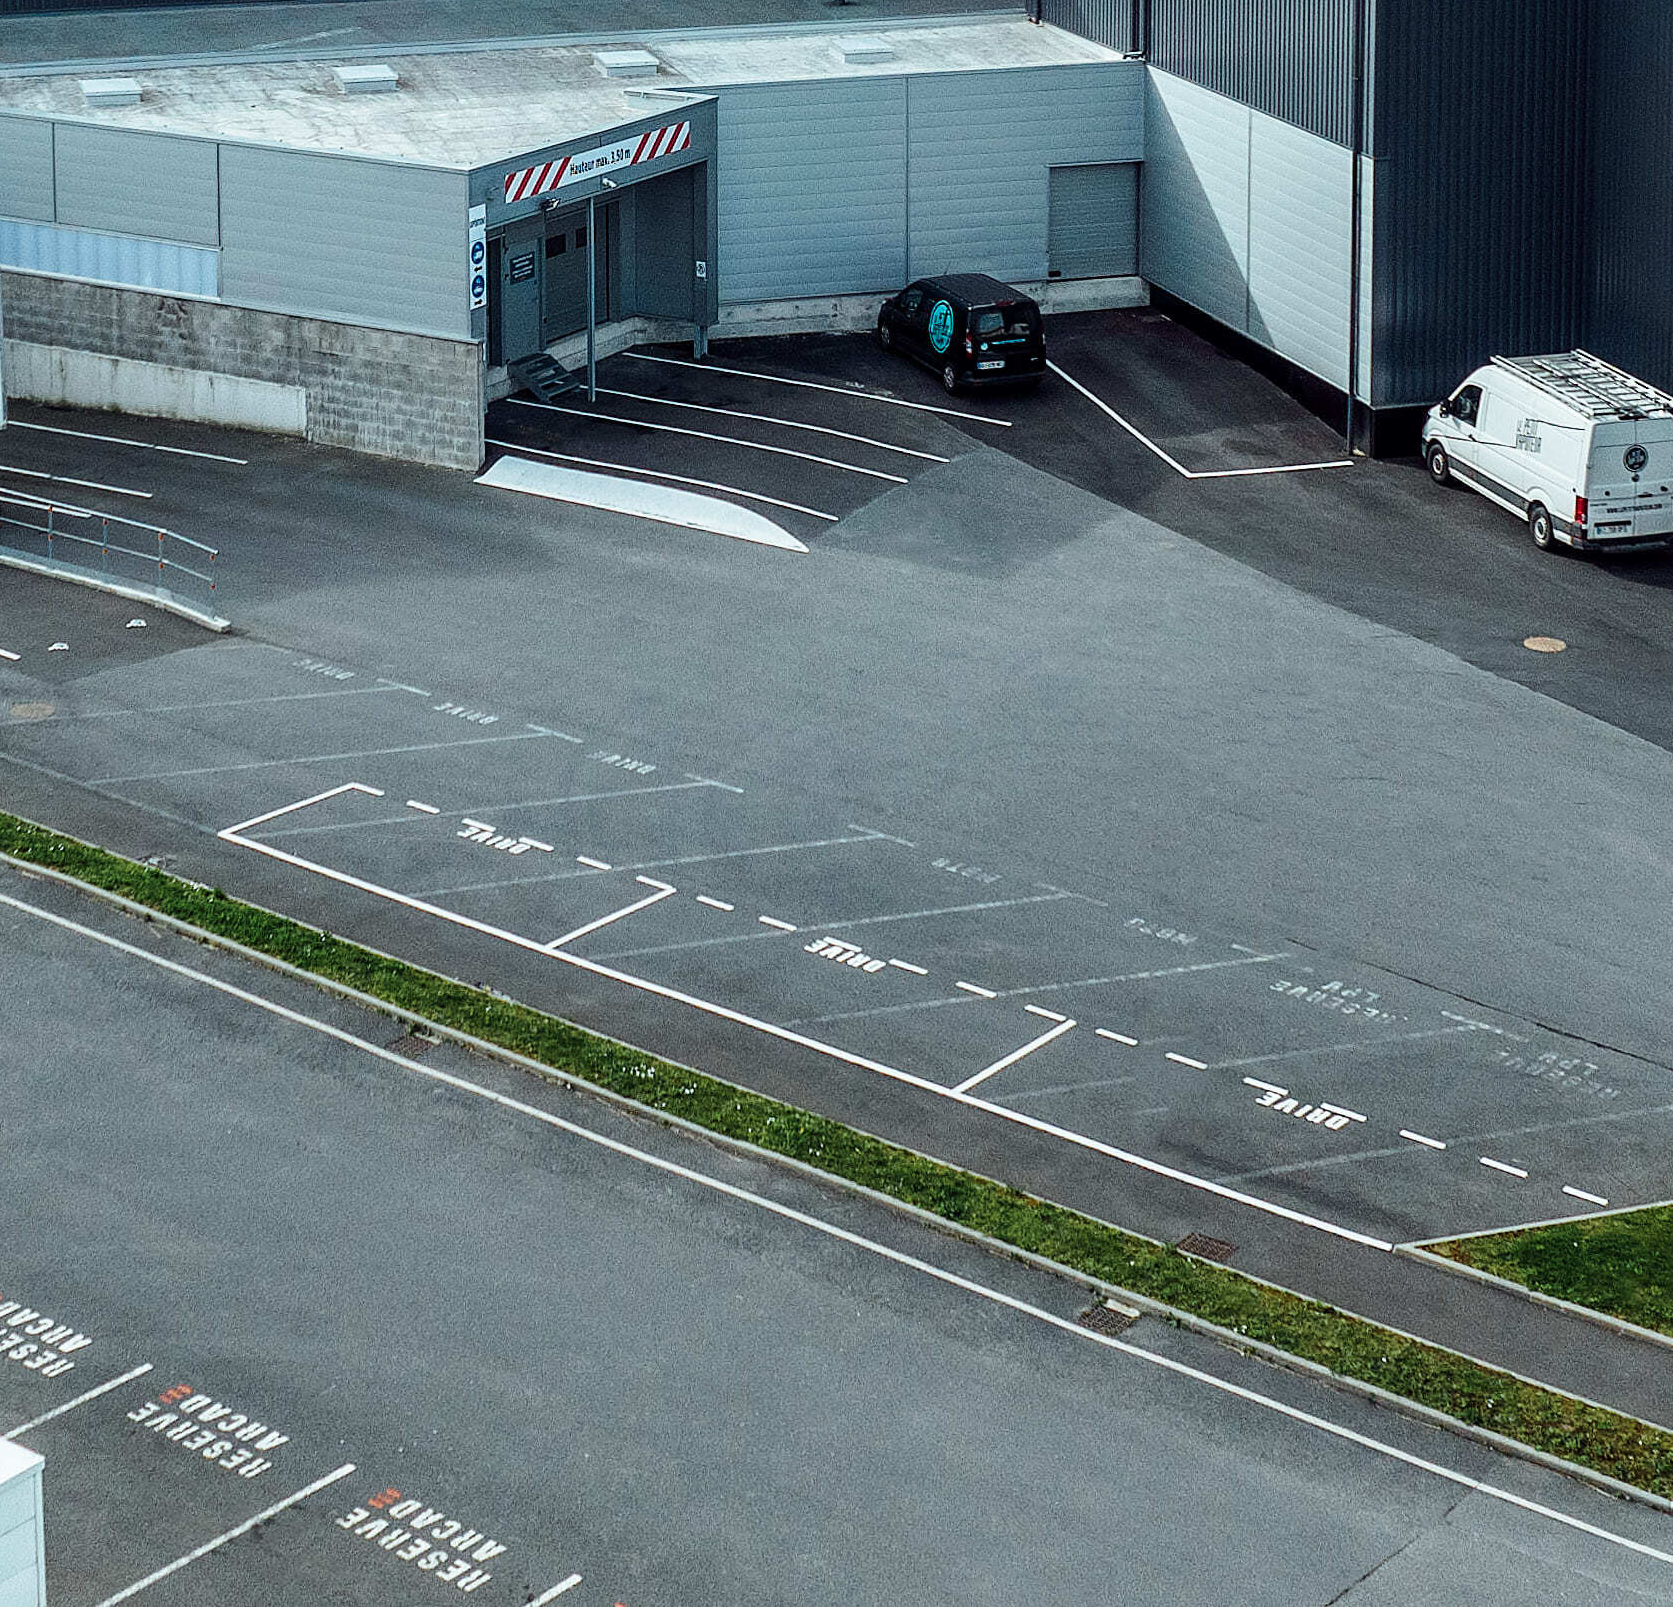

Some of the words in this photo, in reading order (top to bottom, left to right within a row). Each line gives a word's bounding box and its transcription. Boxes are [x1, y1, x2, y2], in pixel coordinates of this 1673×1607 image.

[456, 826, 532, 855] DRIVE
[803, 939, 887, 973] DRIVE
[1254, 1090, 1350, 1130] DRIVE
[127, 1401, 272, 1478] RESERVE
[335, 1506, 492, 1592] RESERVE
